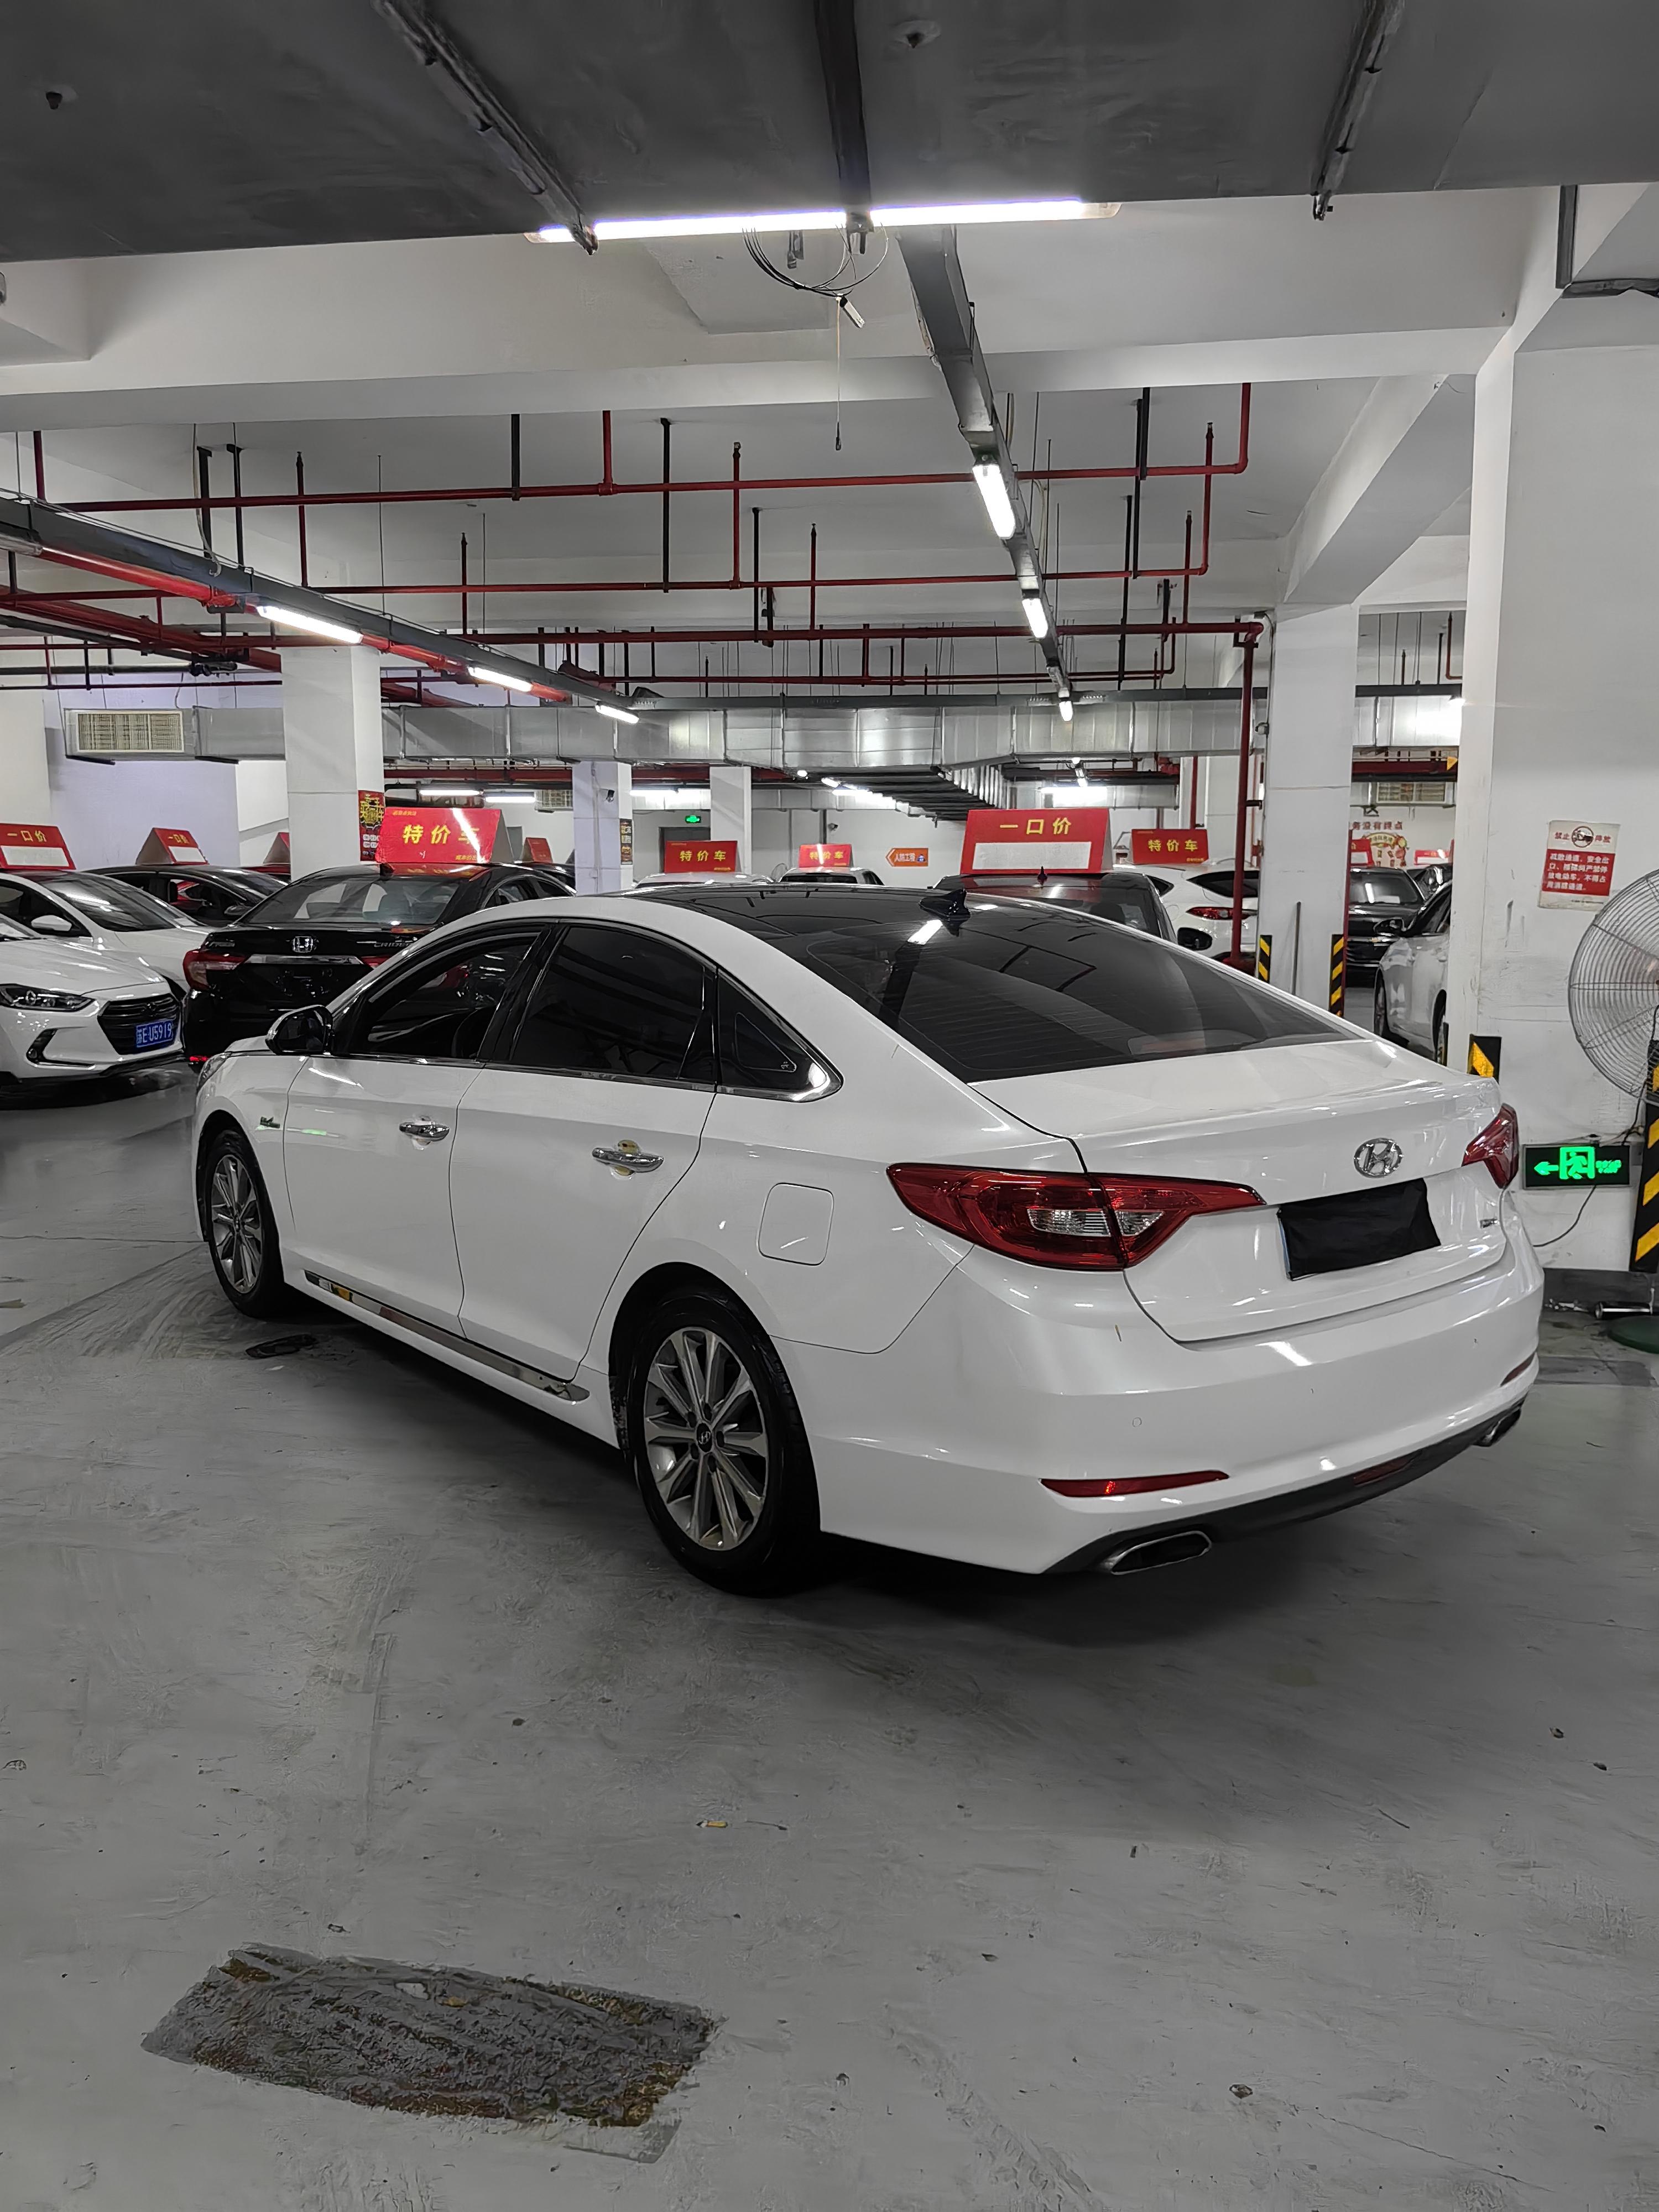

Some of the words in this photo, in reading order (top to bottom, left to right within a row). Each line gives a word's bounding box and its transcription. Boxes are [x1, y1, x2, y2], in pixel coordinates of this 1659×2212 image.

[1000, 817, 1072, 834] 一口价
[7, 830, 47, 842] 一口价
[402, 825, 480, 844] 特价车
[1147, 839, 1198, 852] 特价车
[679, 850, 726, 862] 特价车
